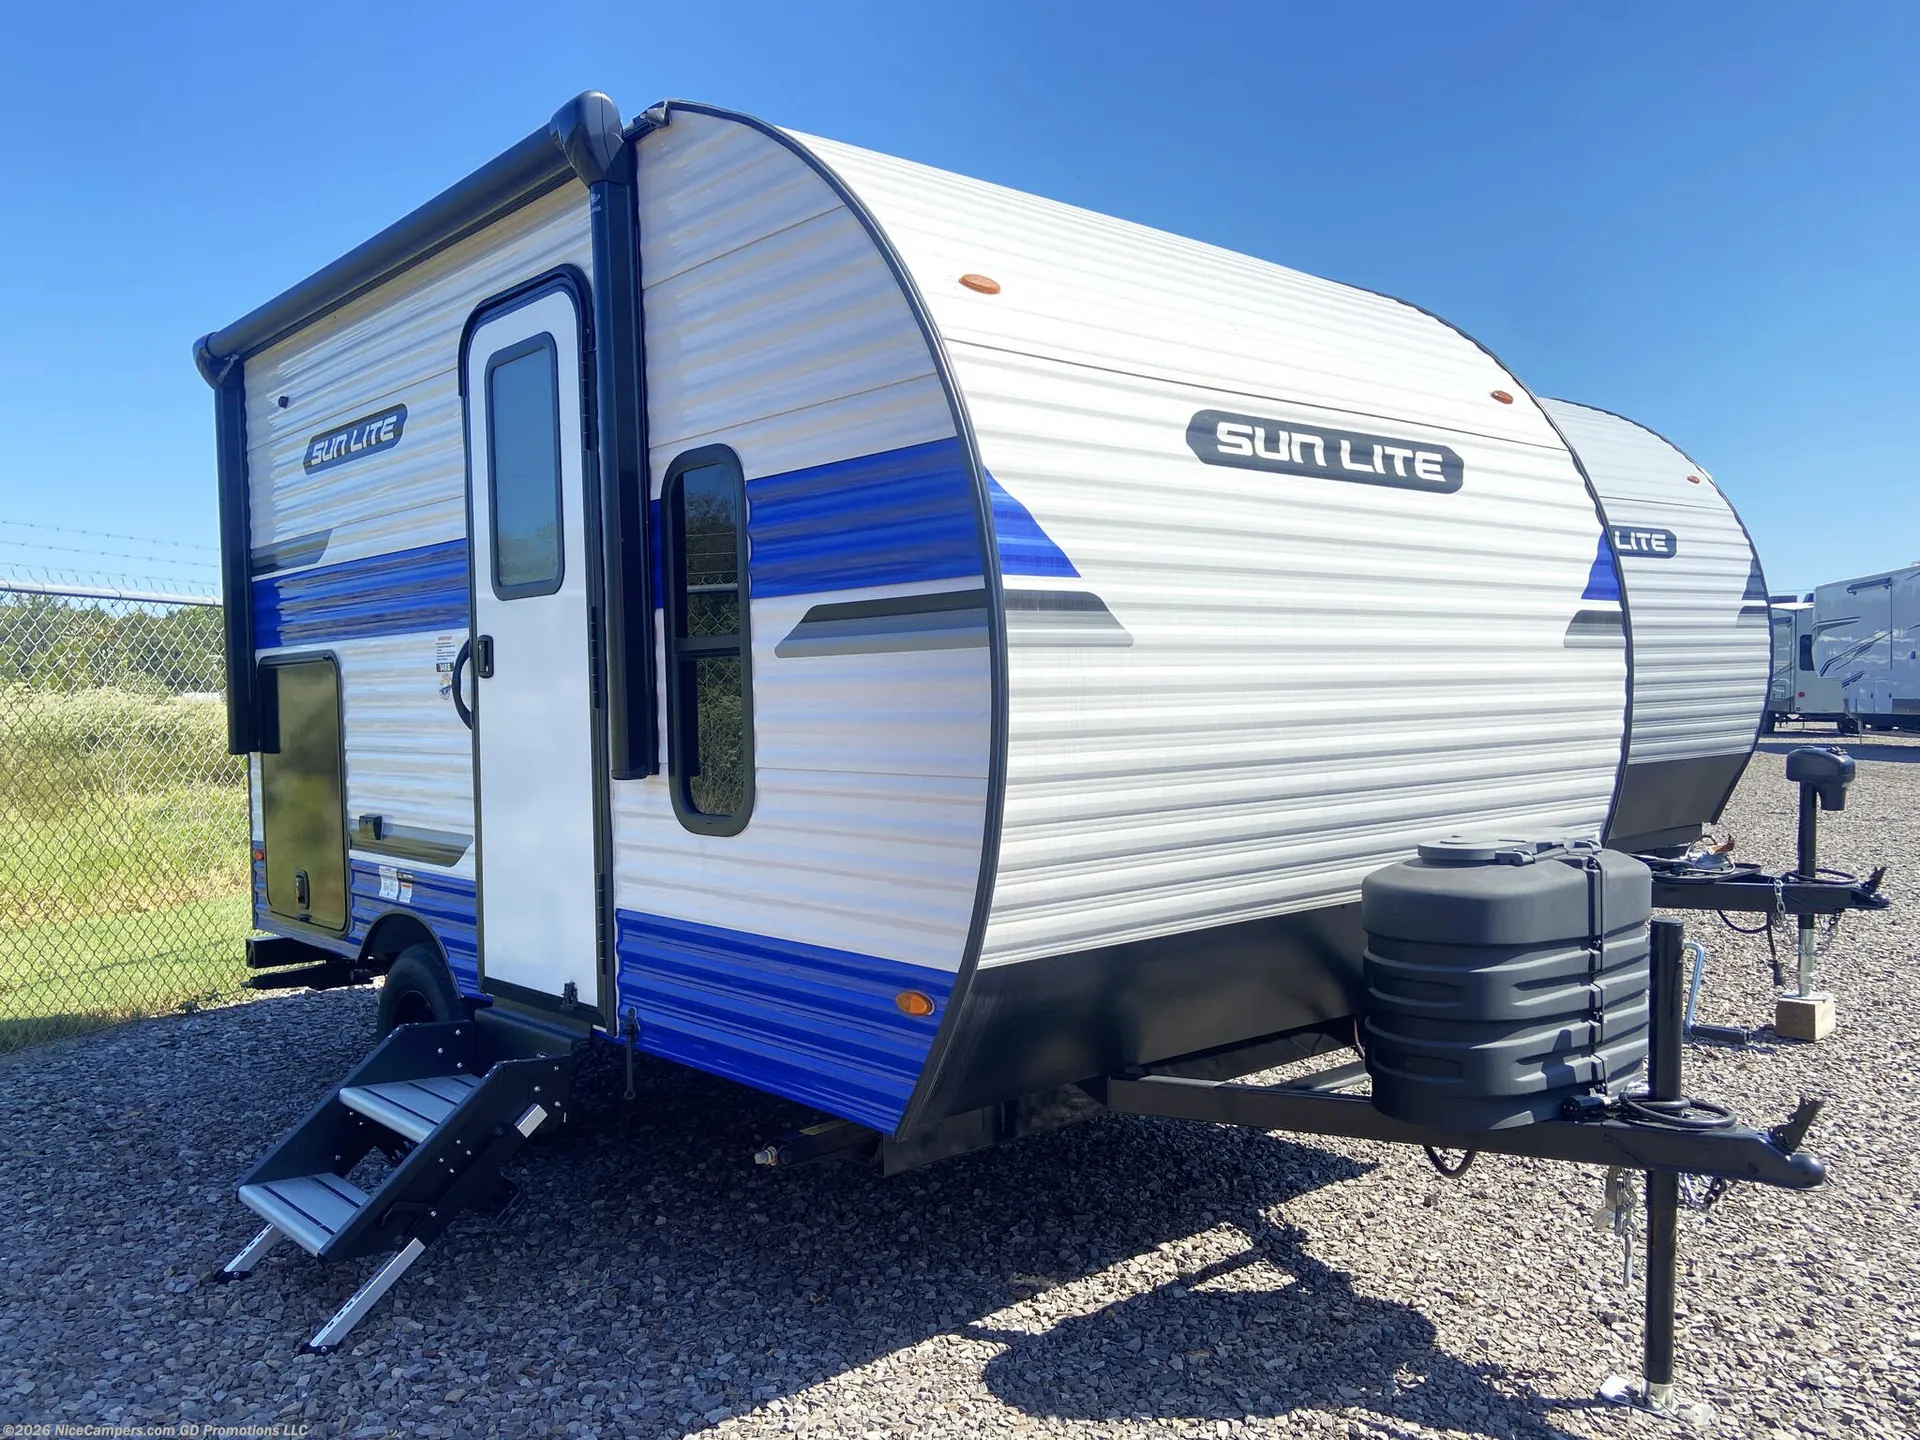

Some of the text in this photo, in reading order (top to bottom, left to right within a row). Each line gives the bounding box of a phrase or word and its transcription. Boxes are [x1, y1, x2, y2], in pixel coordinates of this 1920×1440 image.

[311, 415, 398, 465] SUN LITE
[1216, 421, 1446, 482] SUN LITE
[1614, 531, 1668, 552] LITE
